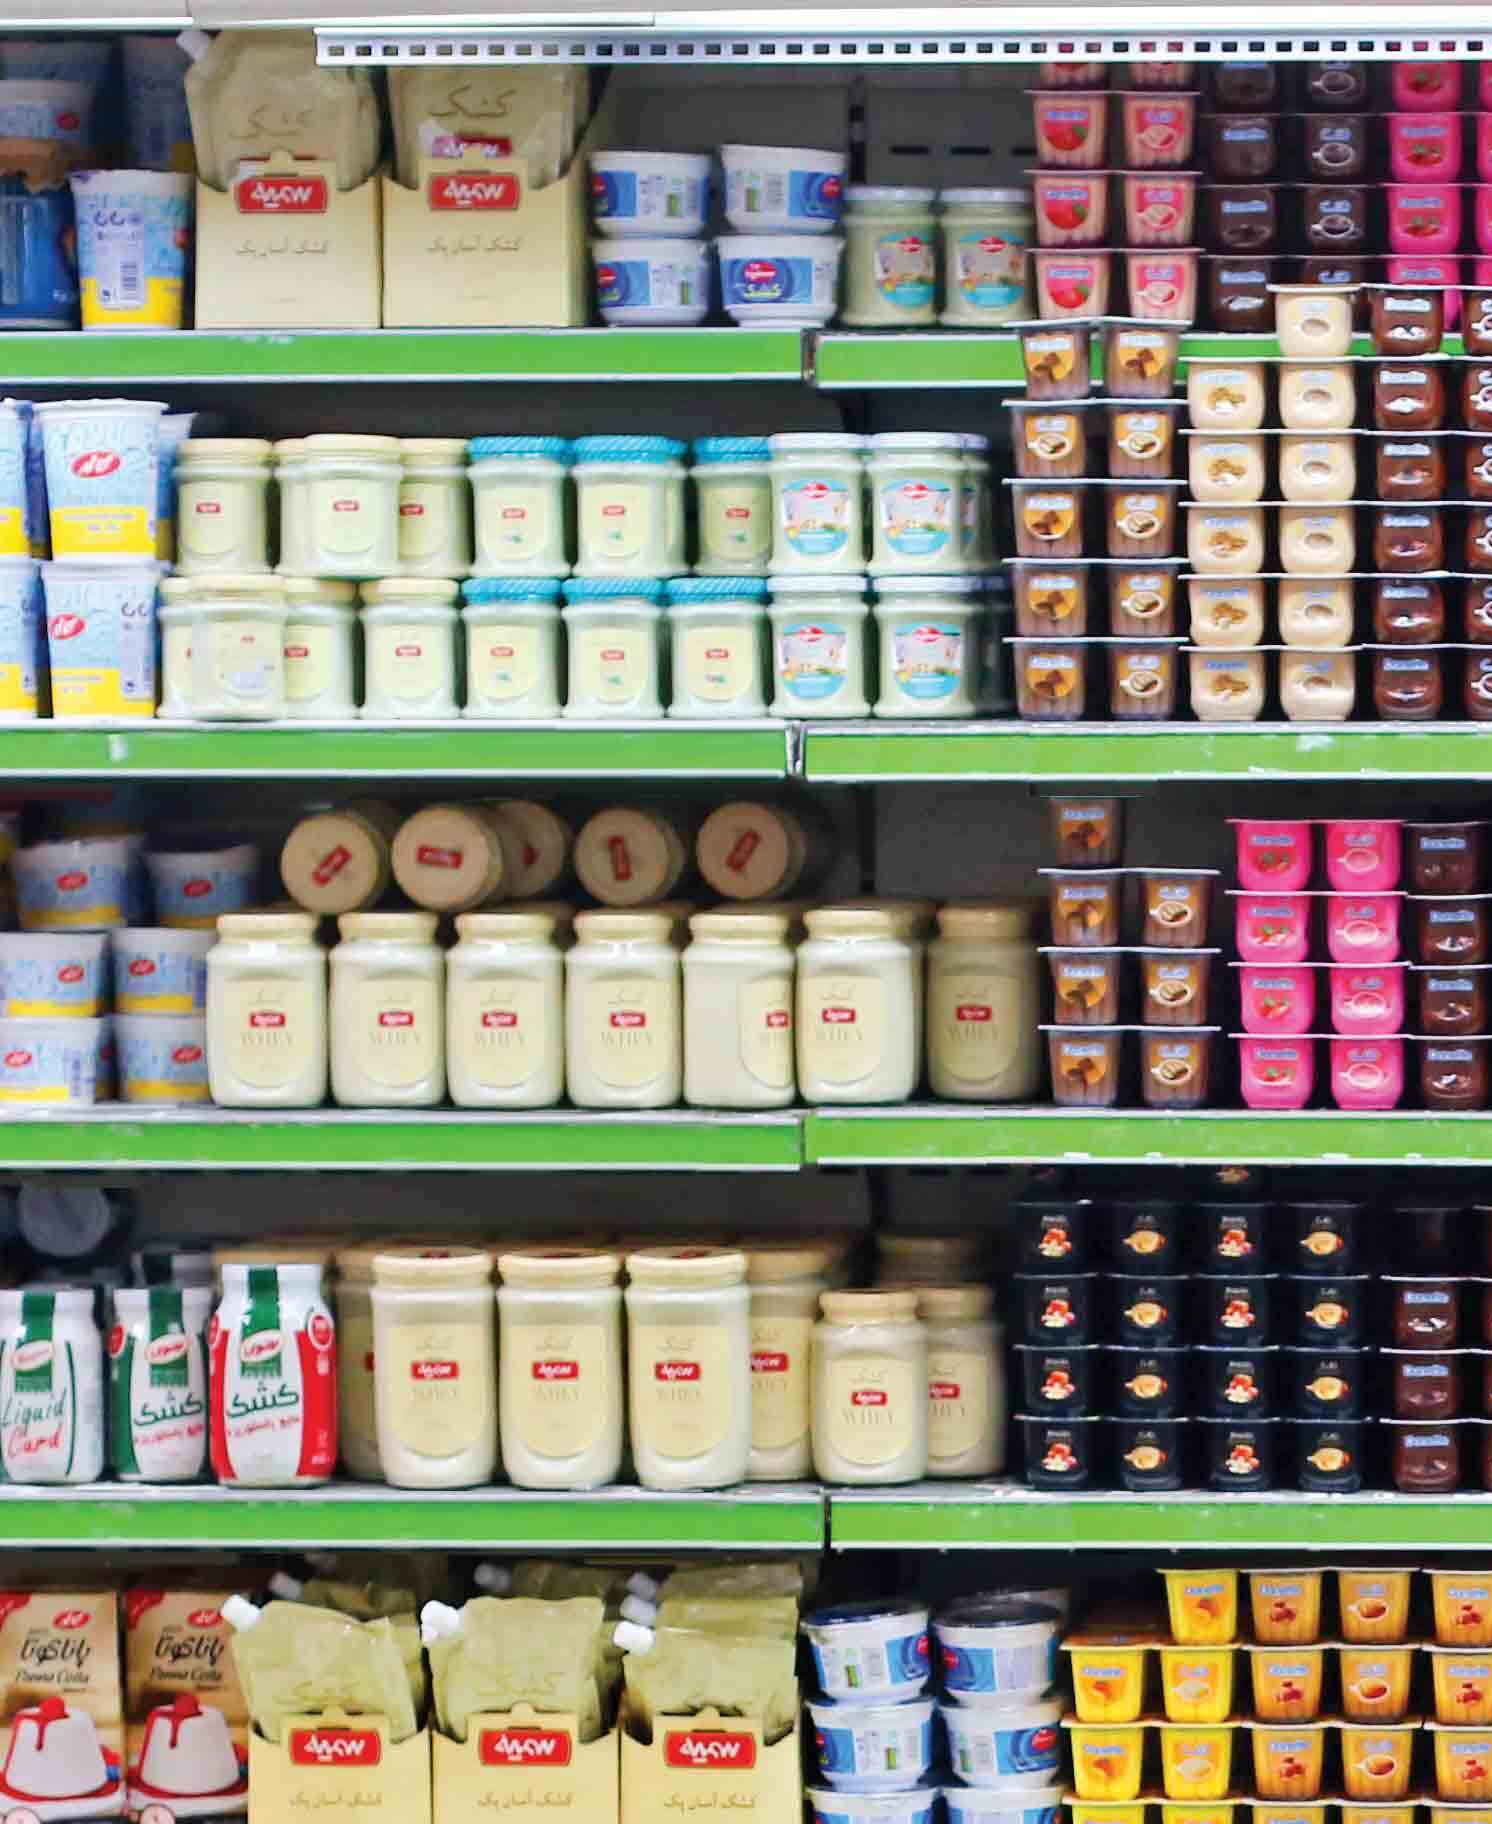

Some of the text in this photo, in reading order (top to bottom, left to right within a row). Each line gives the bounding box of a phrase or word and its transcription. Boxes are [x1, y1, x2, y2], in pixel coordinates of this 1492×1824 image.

[252, 182, 312, 208] سمیه
[443, 180, 504, 205] سمیه
[1, 1389, 66, 1433] Liquid
[135, 1392, 203, 1426] کشک
[227, 1381, 299, 1418] کشک
[7, 1425, 62, 1457] Curd
[304, 1734, 364, 1760] سمیه
[494, 1734, 554, 1760] سمیه
[680, 1736, 740, 1763] سمیه
